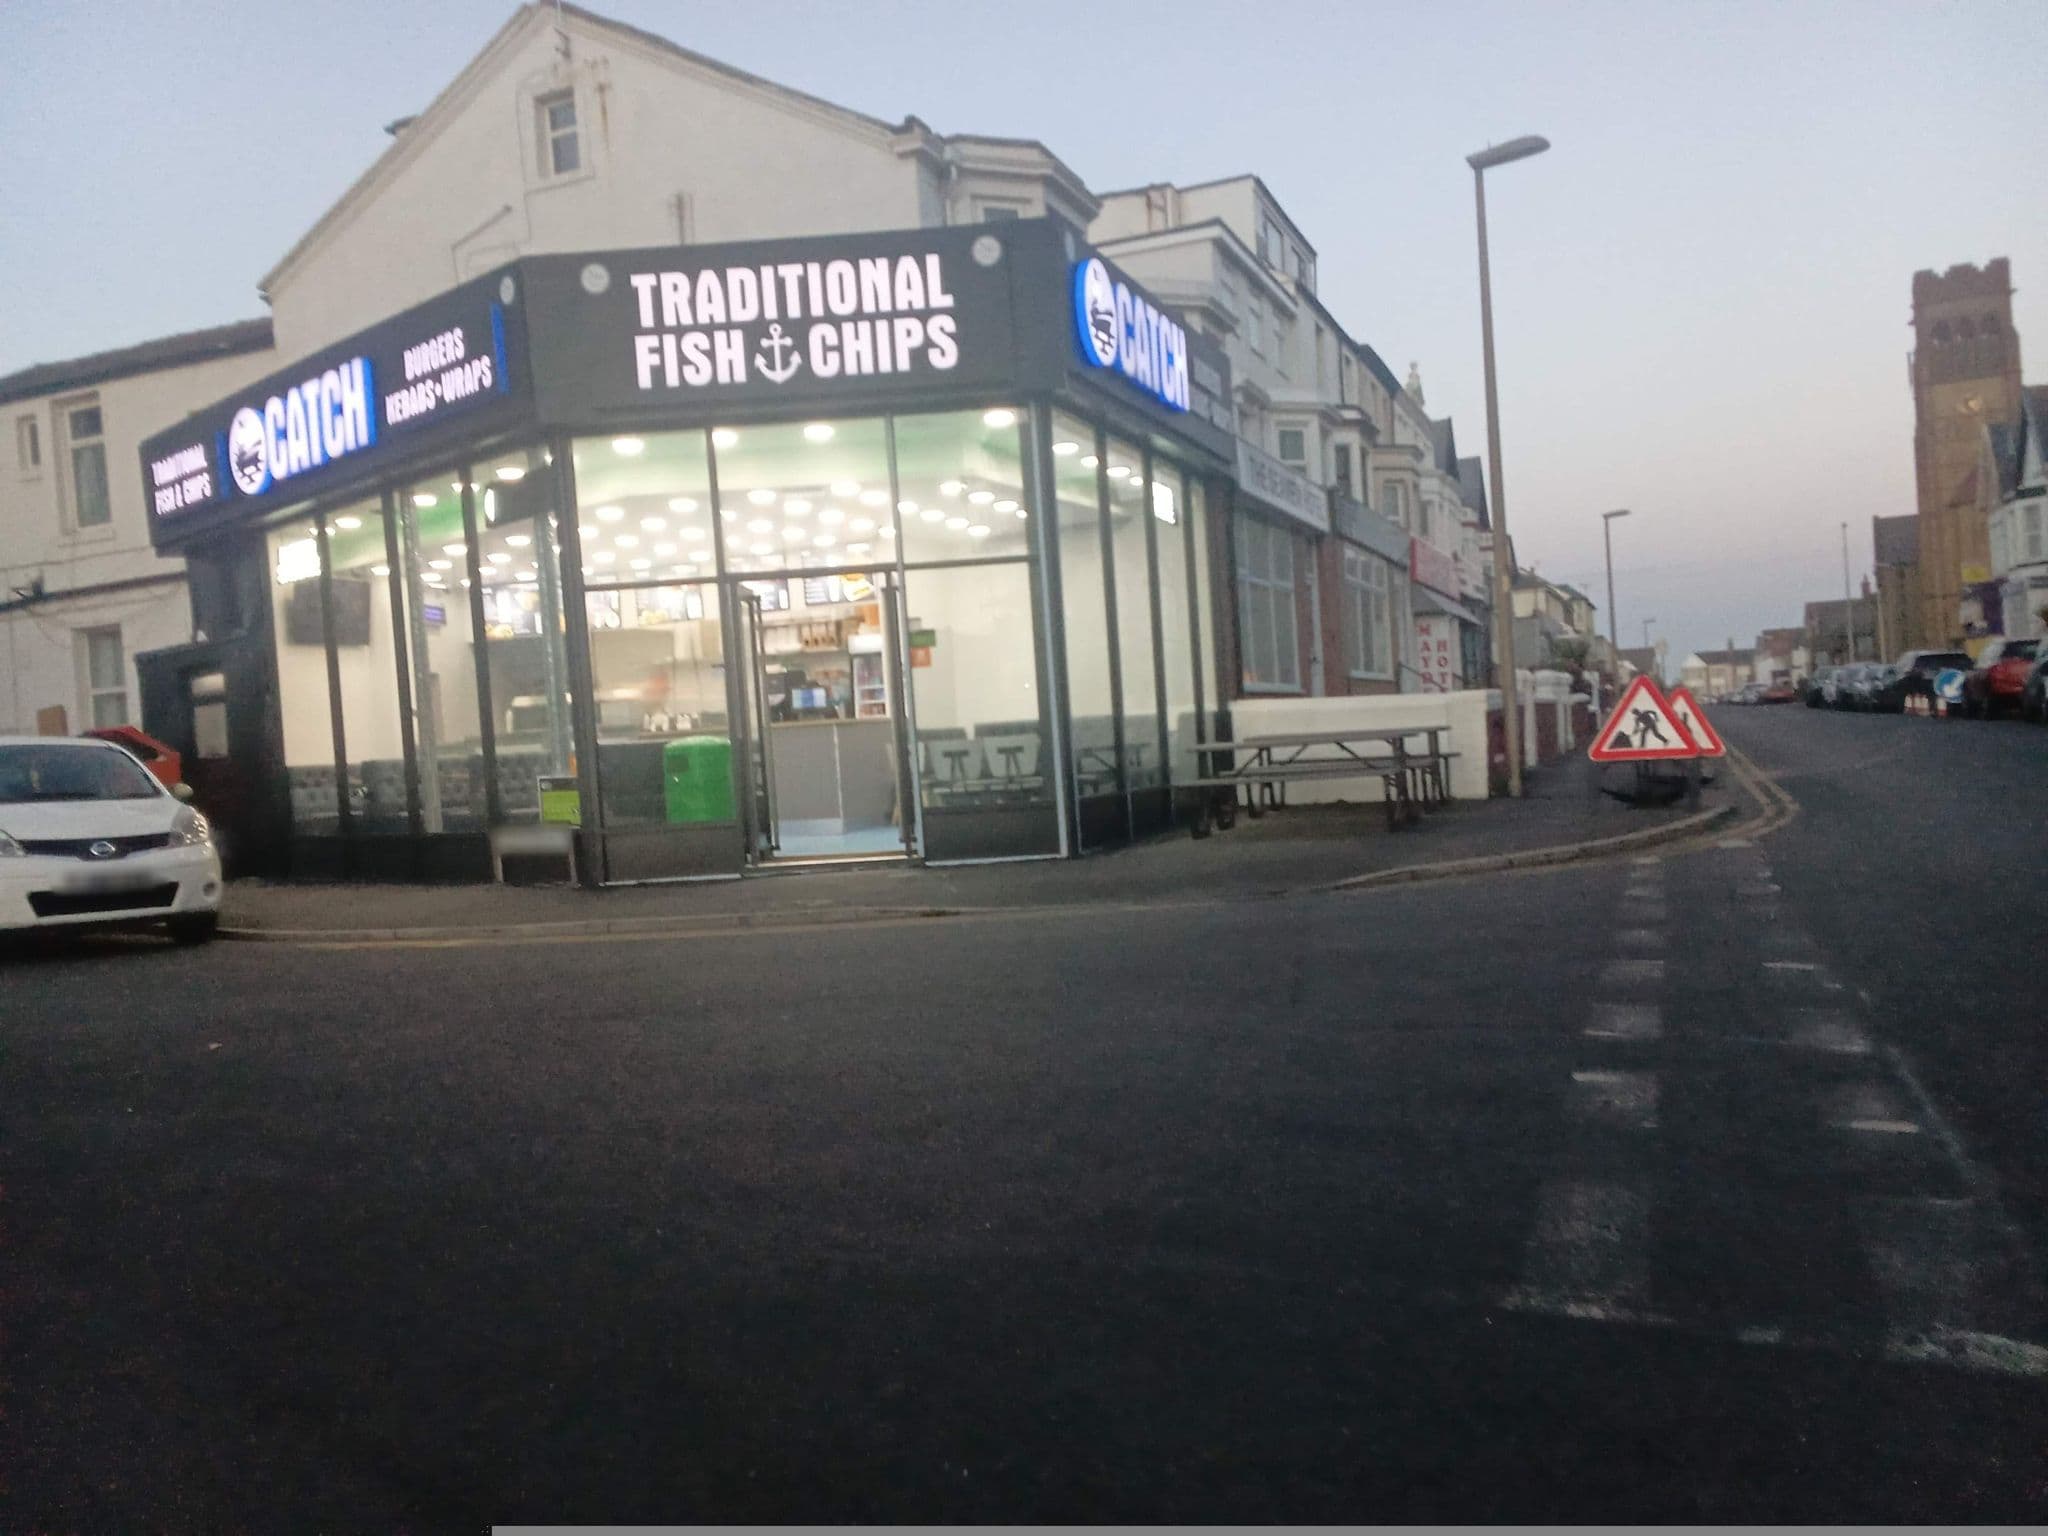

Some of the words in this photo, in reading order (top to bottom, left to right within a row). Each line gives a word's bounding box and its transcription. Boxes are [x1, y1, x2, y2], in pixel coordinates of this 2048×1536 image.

[630, 253, 955, 328] TRADITIONAL
[403, 326, 464, 381] BURGERS
[634, 329, 746, 389] FISH
[808, 314, 958, 378] CHIPS
[1116, 281, 1190, 412] CATCH
[264, 356, 370, 480] CATCH
